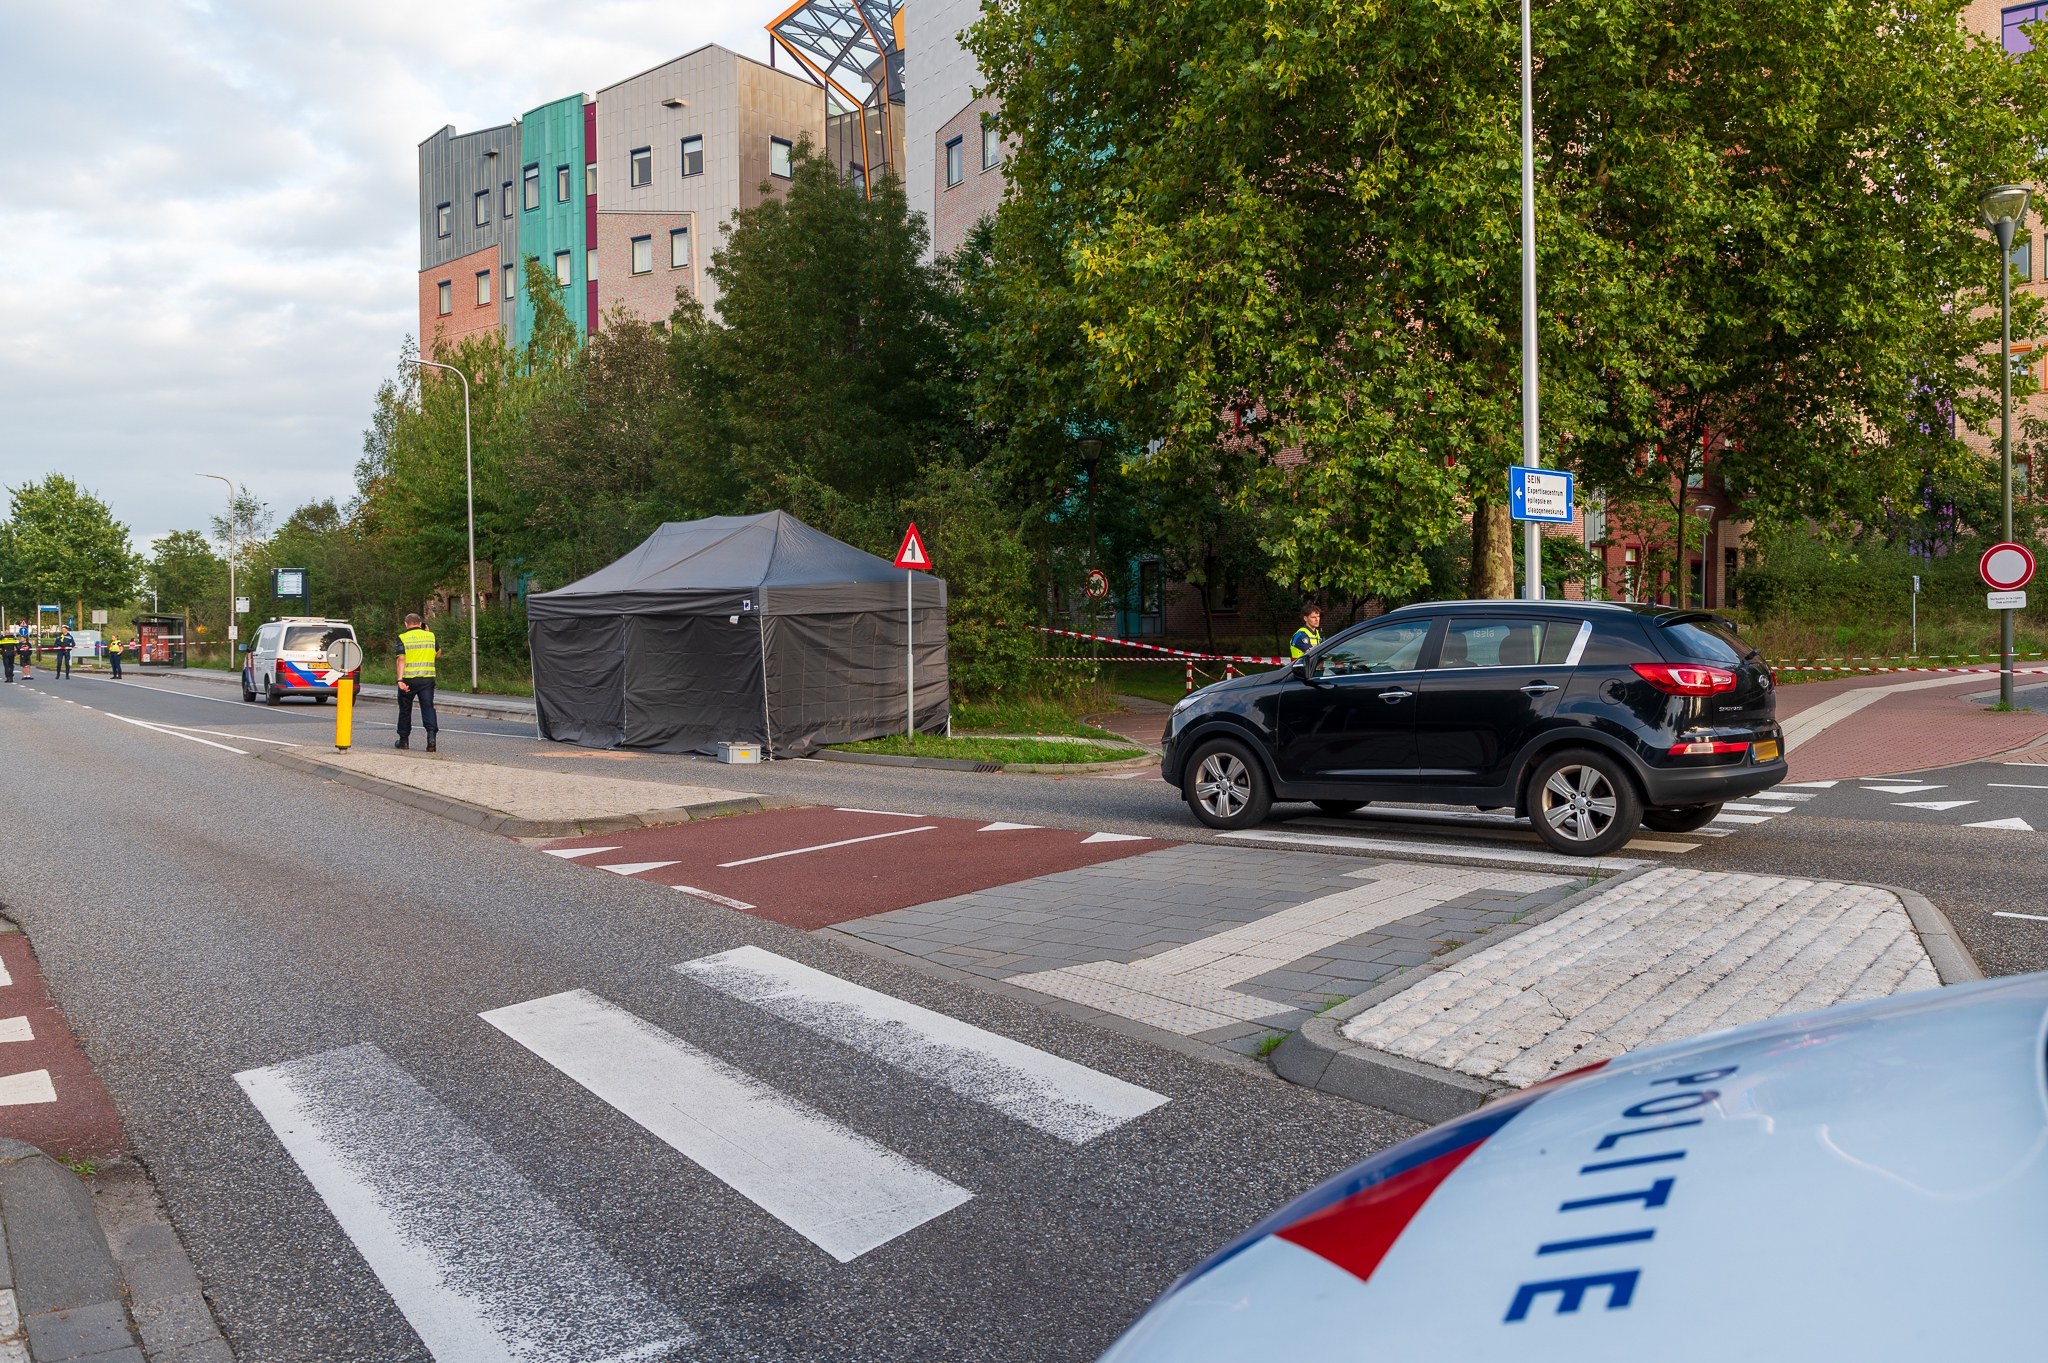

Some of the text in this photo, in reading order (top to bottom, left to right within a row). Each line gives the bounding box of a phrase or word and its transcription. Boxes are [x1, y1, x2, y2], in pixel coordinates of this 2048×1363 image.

[1527, 475, 1541, 484] SEIN
[1527, 487, 1564, 496] Expertisecentrum
[1527, 497, 1546, 505] epilepsie
[1527, 507, 1564, 515] slaapgeneeskunde
[1502, 1065, 1740, 1324] POLITIE
